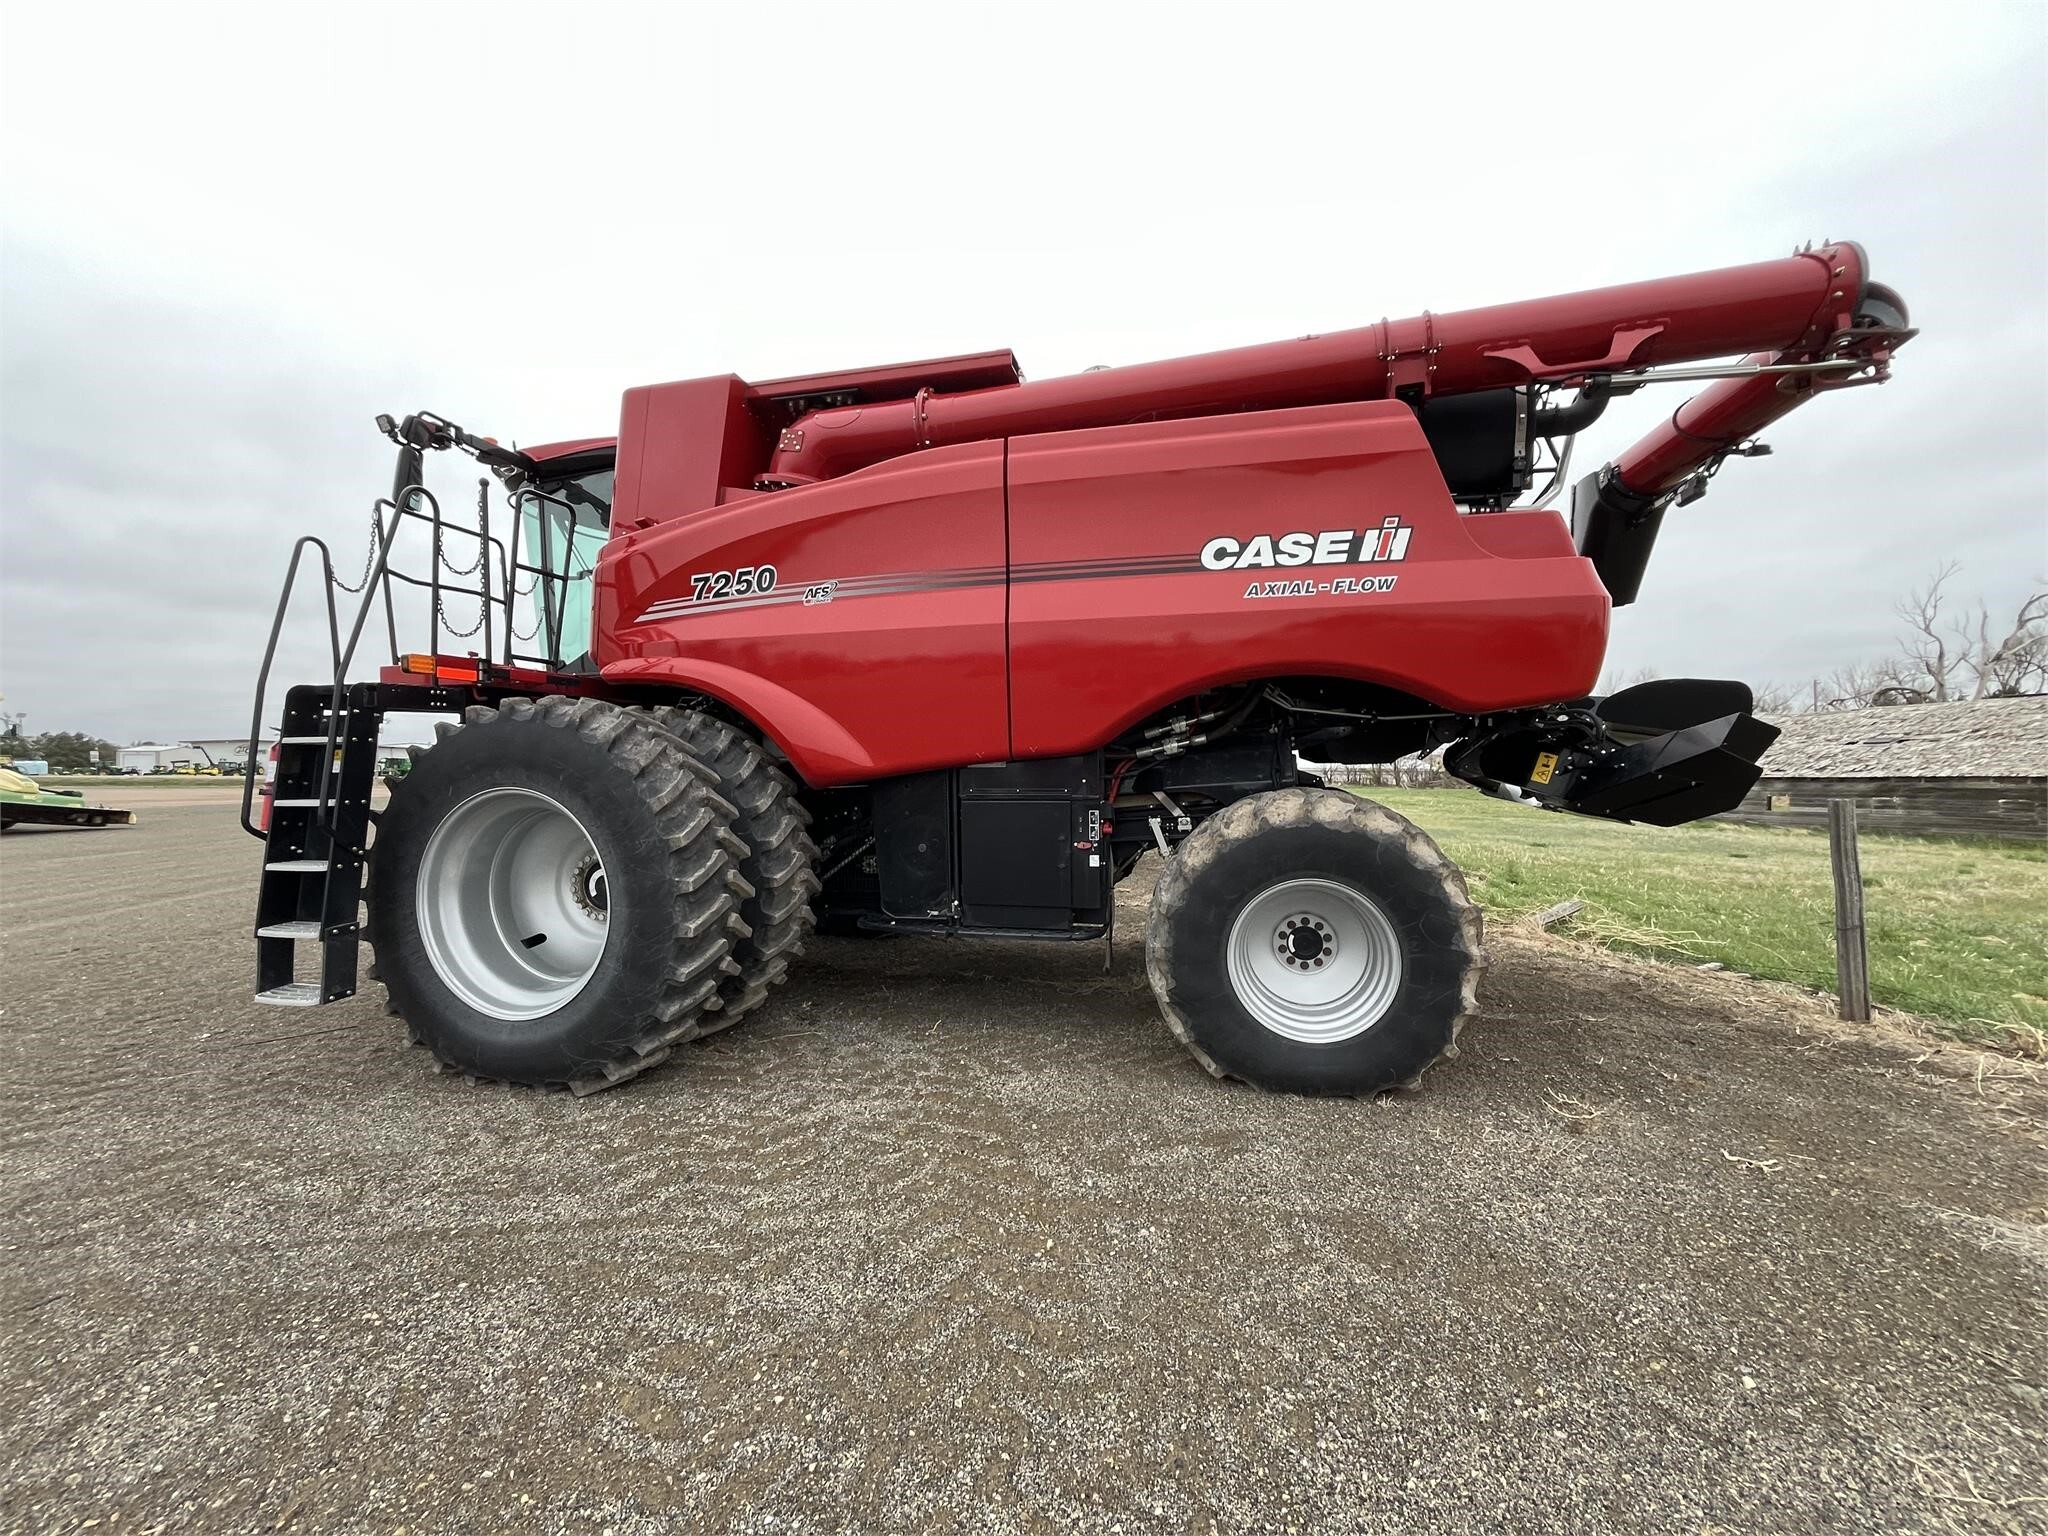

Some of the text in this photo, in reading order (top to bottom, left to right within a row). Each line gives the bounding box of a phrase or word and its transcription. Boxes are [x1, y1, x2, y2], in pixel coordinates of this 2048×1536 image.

[1200, 530, 1355, 570] CASE
[690, 564, 777, 602] 7250
[803, 585, 830, 599] AFS
[1244, 576, 1398, 598] AXIAL-FLOW
